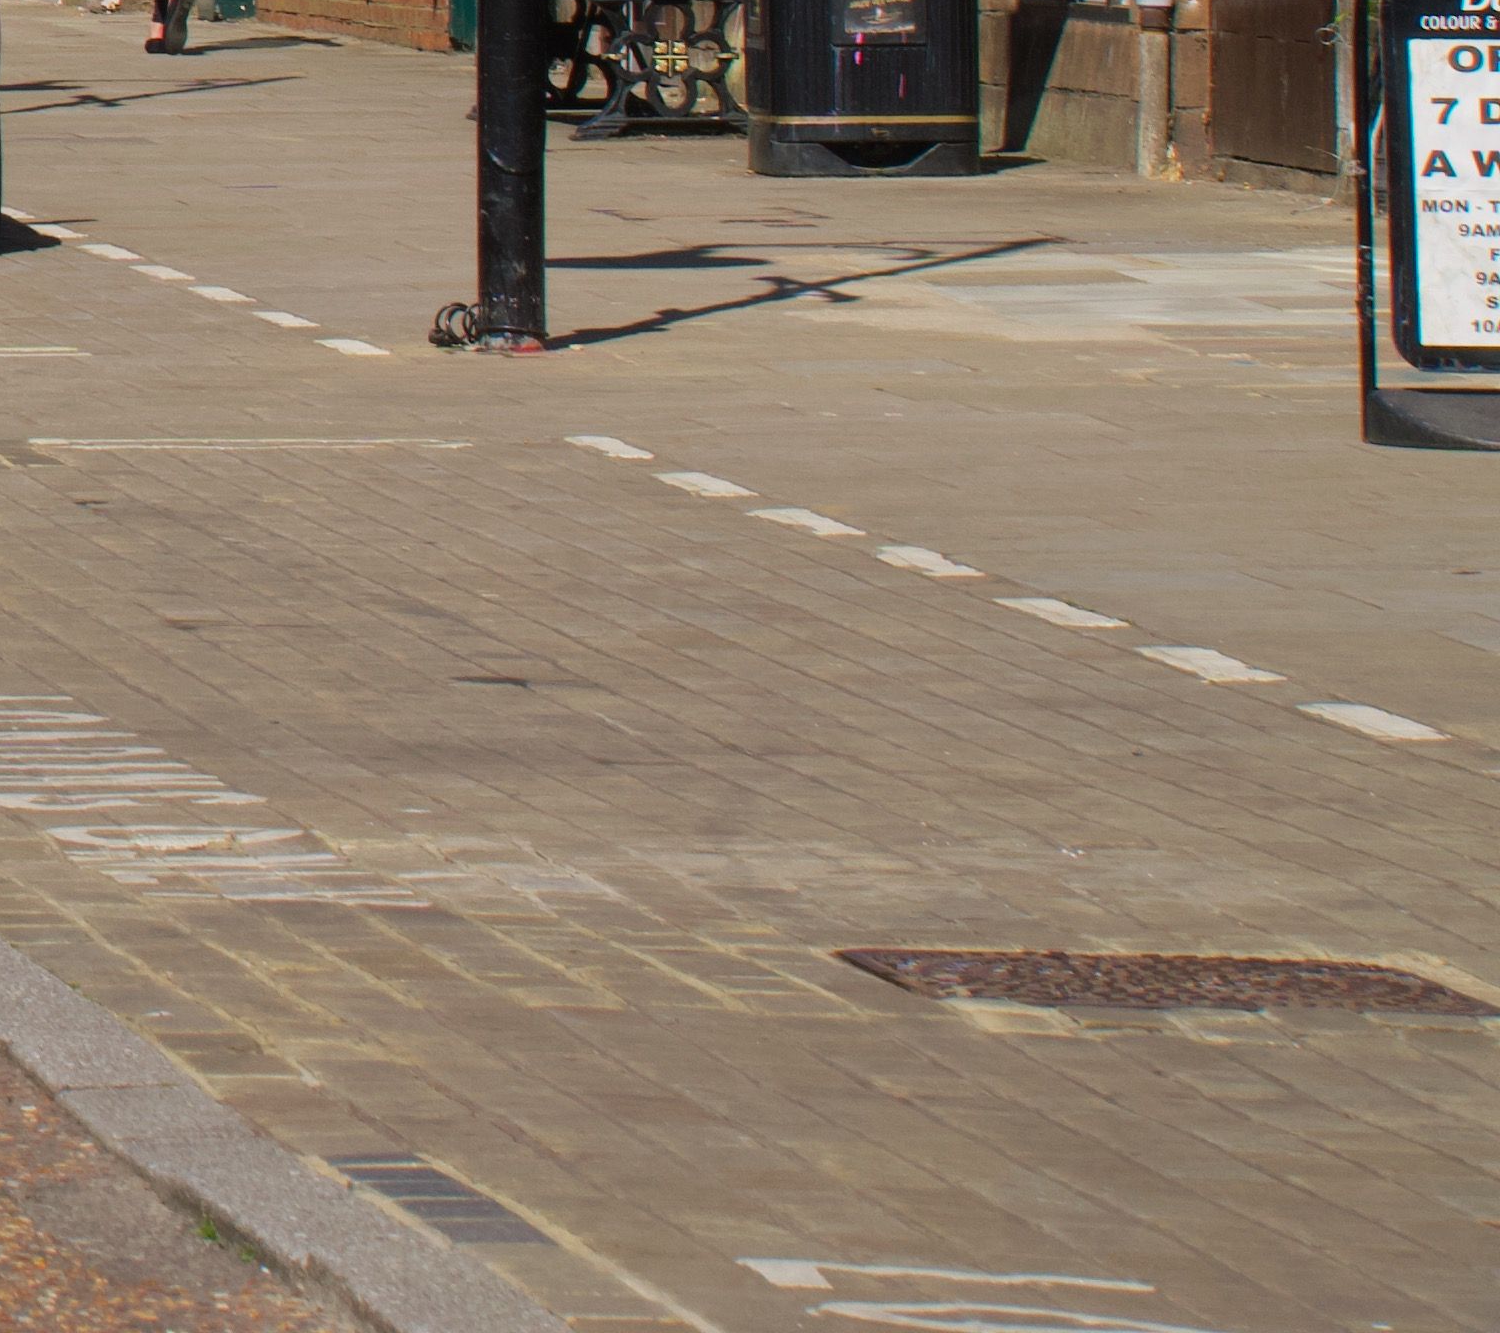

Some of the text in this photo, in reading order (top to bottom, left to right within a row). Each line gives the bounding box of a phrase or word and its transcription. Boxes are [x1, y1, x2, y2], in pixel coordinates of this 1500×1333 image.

[1420, 15, 1499, 30] COLOUR &
[1430, 97, 1500, 125] 7 D
[1420, 149, 1500, 178] A W
[1422, 199, 1469, 213] MON
[1489, 200, 1500, 213] T
[1458, 223, 1500, 238] 9AM
[1475, 271, 1500, 285] 9A
[1485, 295, 1500, 310] S
[1471, 319, 1500, 334] 10
